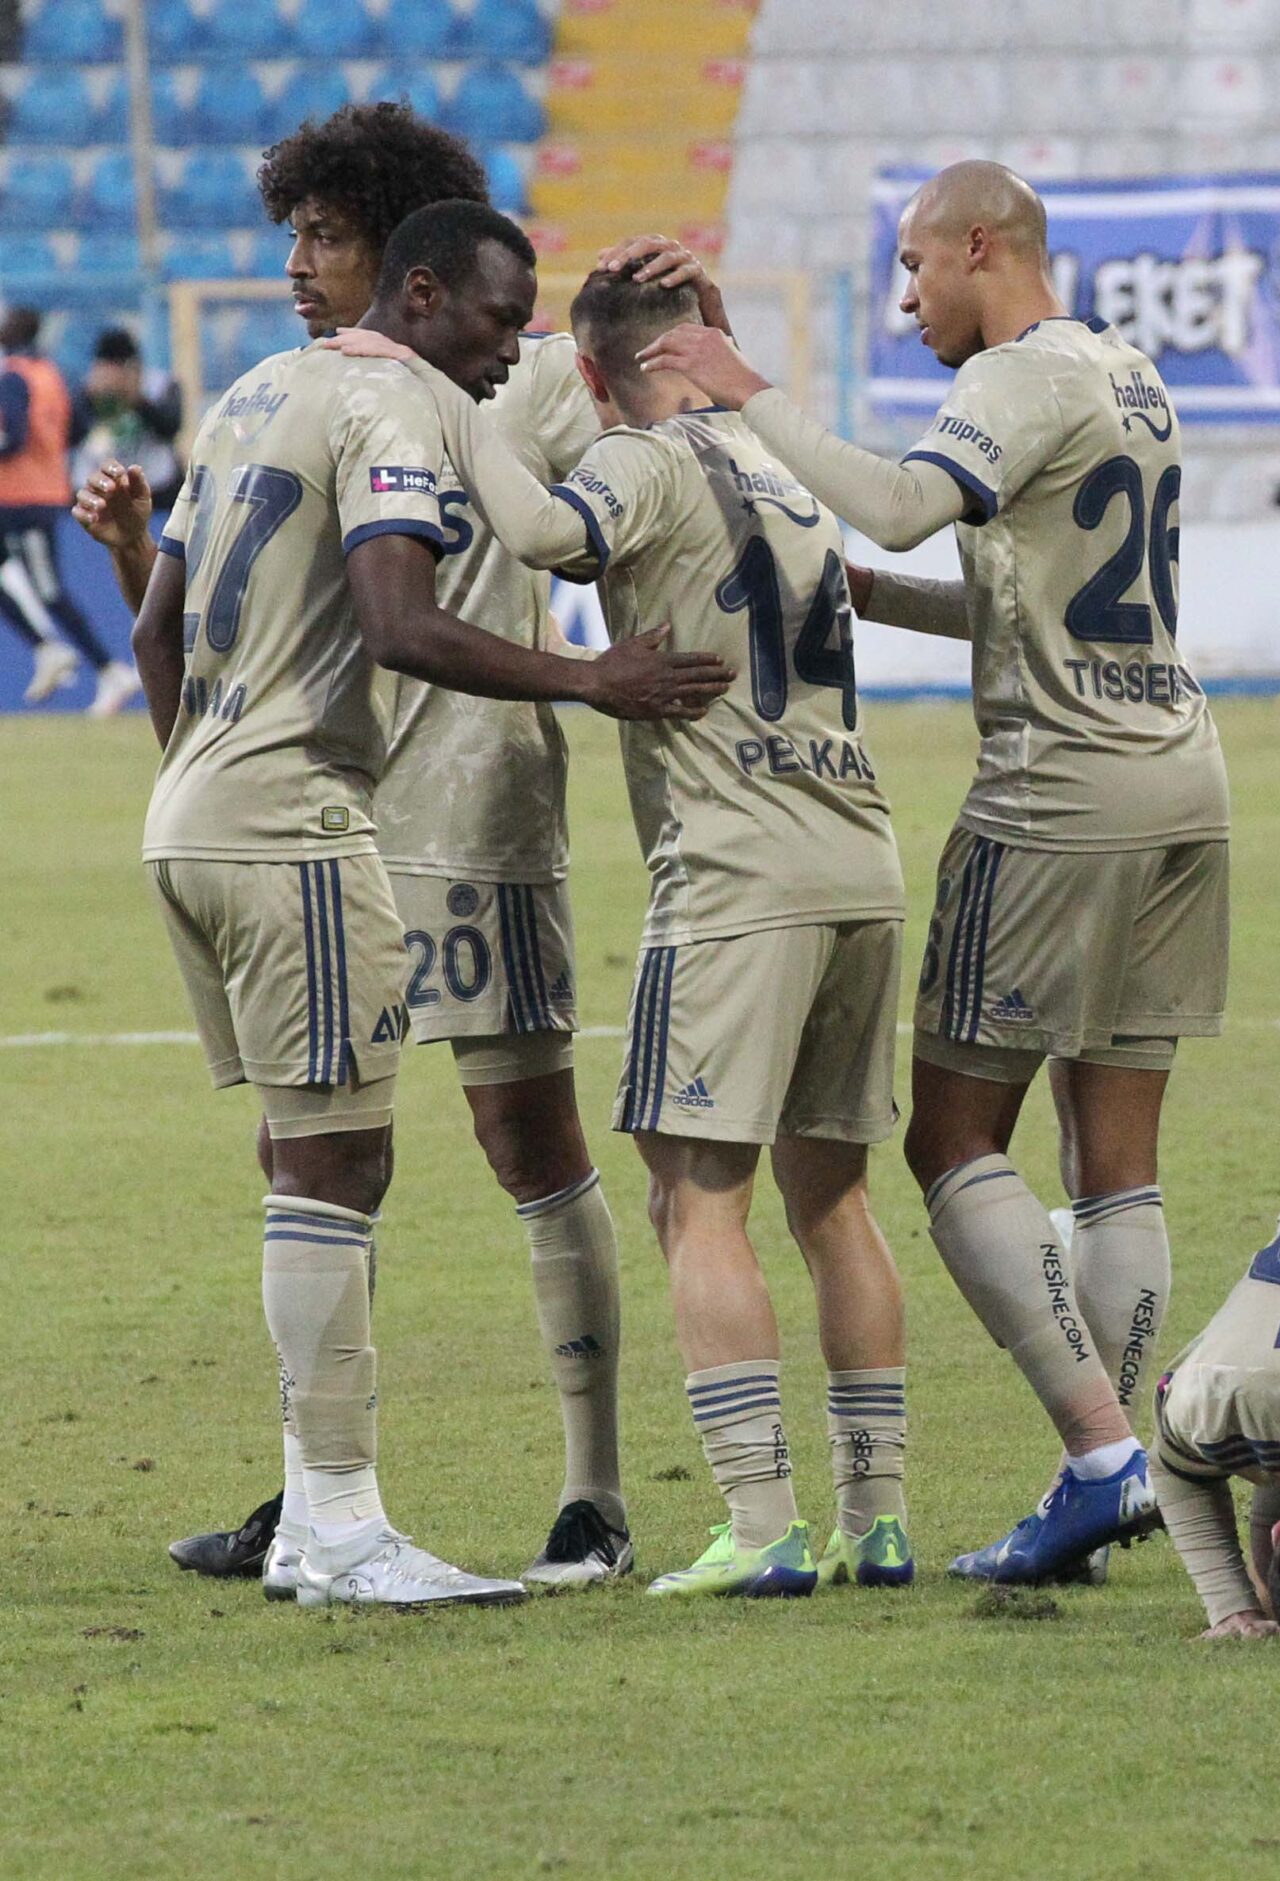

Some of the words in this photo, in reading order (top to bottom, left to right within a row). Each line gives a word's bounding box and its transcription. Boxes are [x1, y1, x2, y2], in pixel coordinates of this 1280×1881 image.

[715, 535, 856, 732] 14
[1065, 455, 1182, 642] 26
[403, 924, 493, 1010] 20
